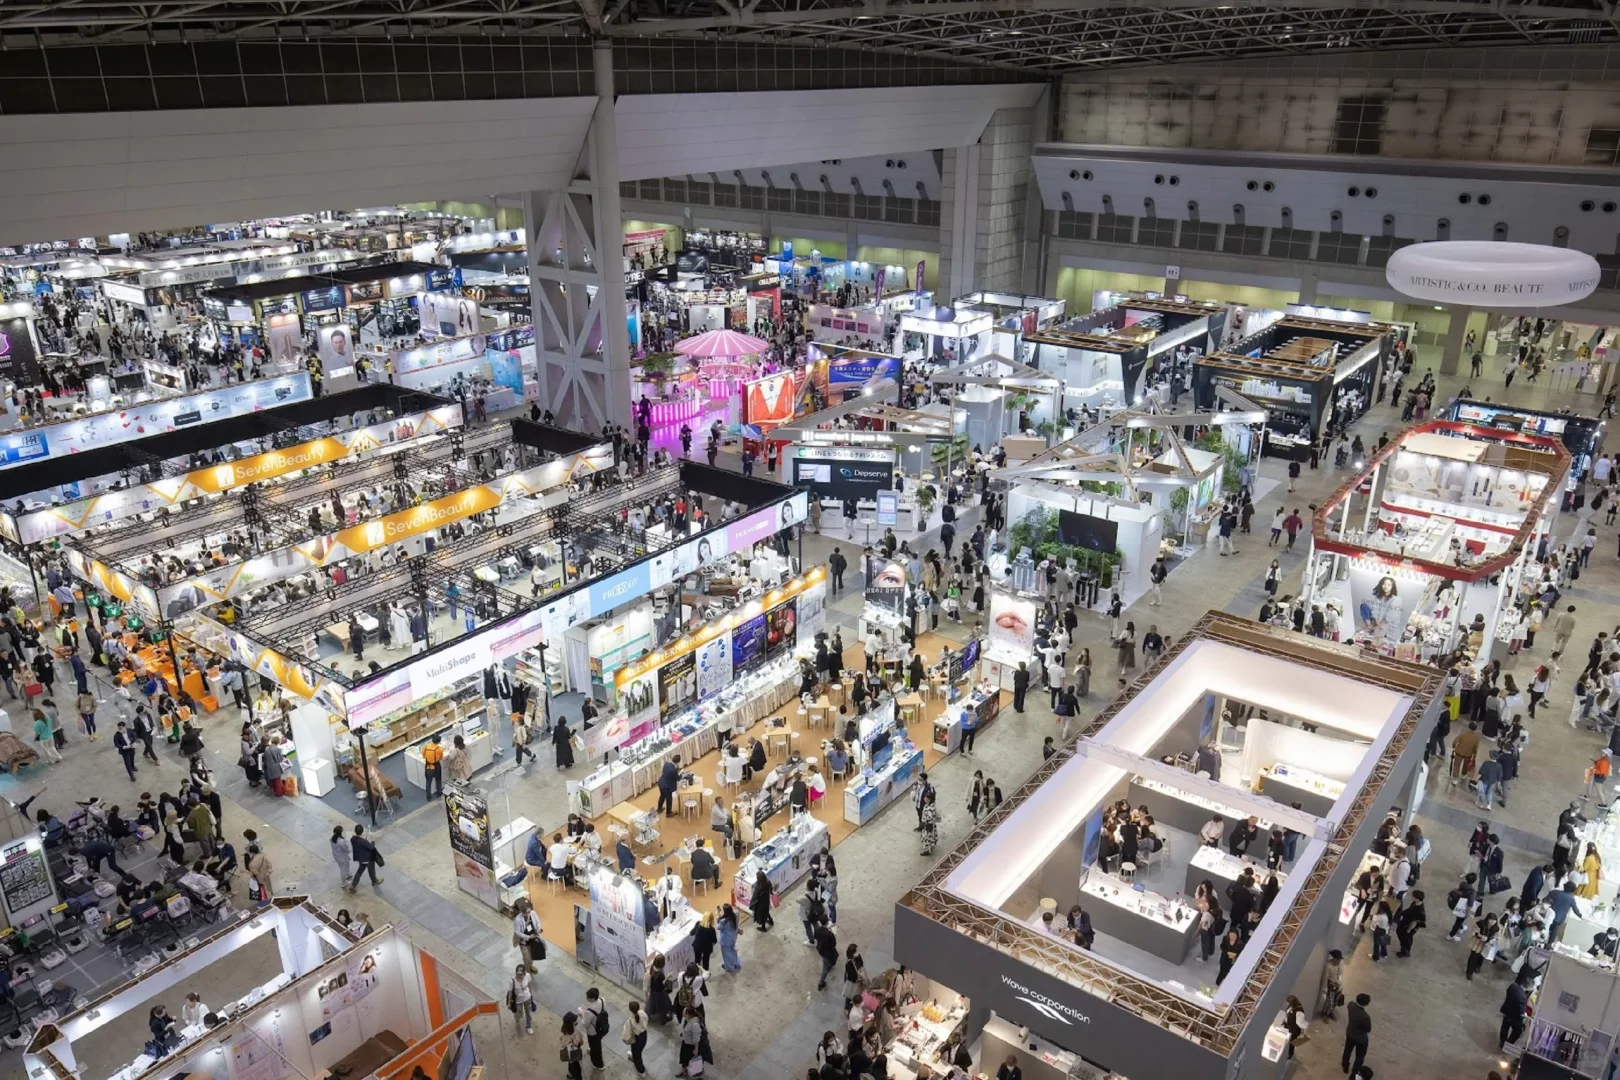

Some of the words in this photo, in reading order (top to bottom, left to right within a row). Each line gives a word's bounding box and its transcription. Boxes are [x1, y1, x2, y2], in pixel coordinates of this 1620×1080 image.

[1411, 275, 1488, 293] ARTISTIC&CO.
[236, 446, 325, 479] SevenBeauty
[854, 469, 889, 478] Depserve
[387, 498, 477, 536] SevenBeauty
[425, 651, 477, 681] MultiShape
[1001, 974, 1029, 994] Wave
[1030, 990, 1091, 1025] corporation
